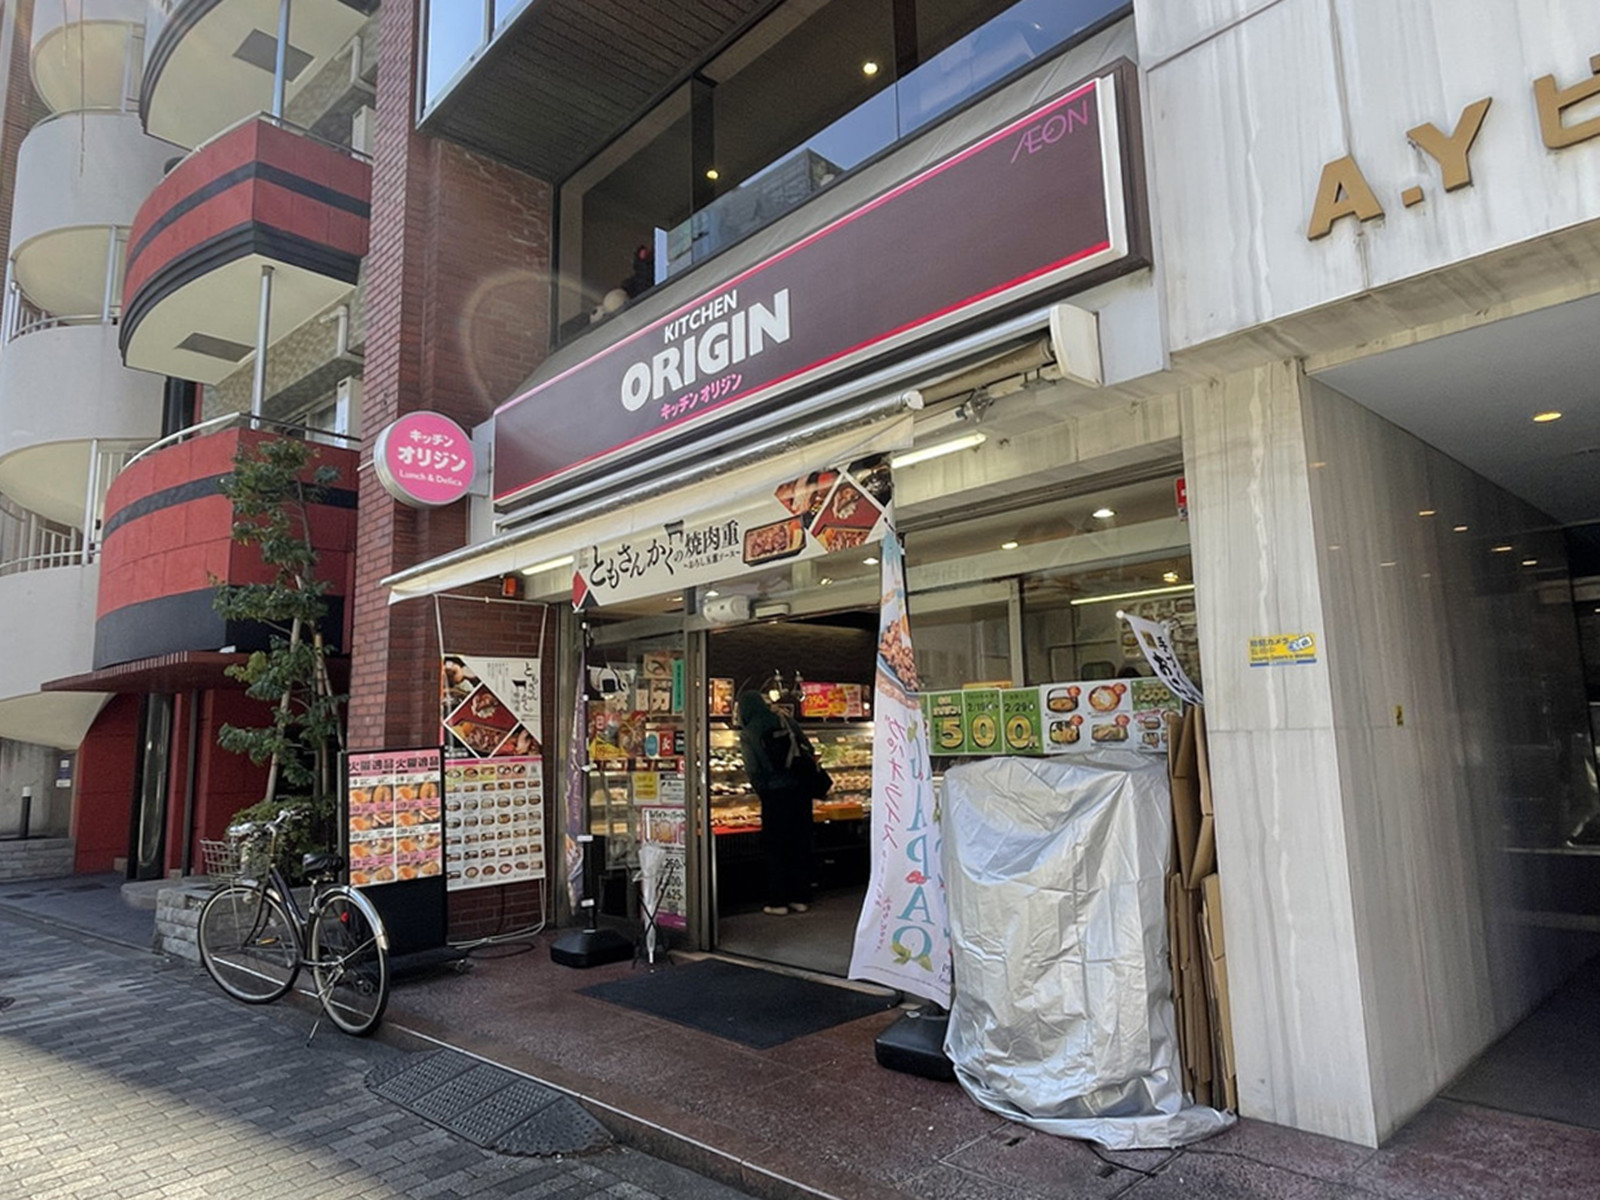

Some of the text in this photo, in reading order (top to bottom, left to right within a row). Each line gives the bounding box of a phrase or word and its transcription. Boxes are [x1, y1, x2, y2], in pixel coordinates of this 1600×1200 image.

[664, 288, 738, 344] KITCHEN
[621, 287, 791, 412] ORIGIN
[660, 373, 742, 420] キッチン オリジン
[397, 445, 467, 472] オリジン
[409, 429, 454, 448] キッチン
